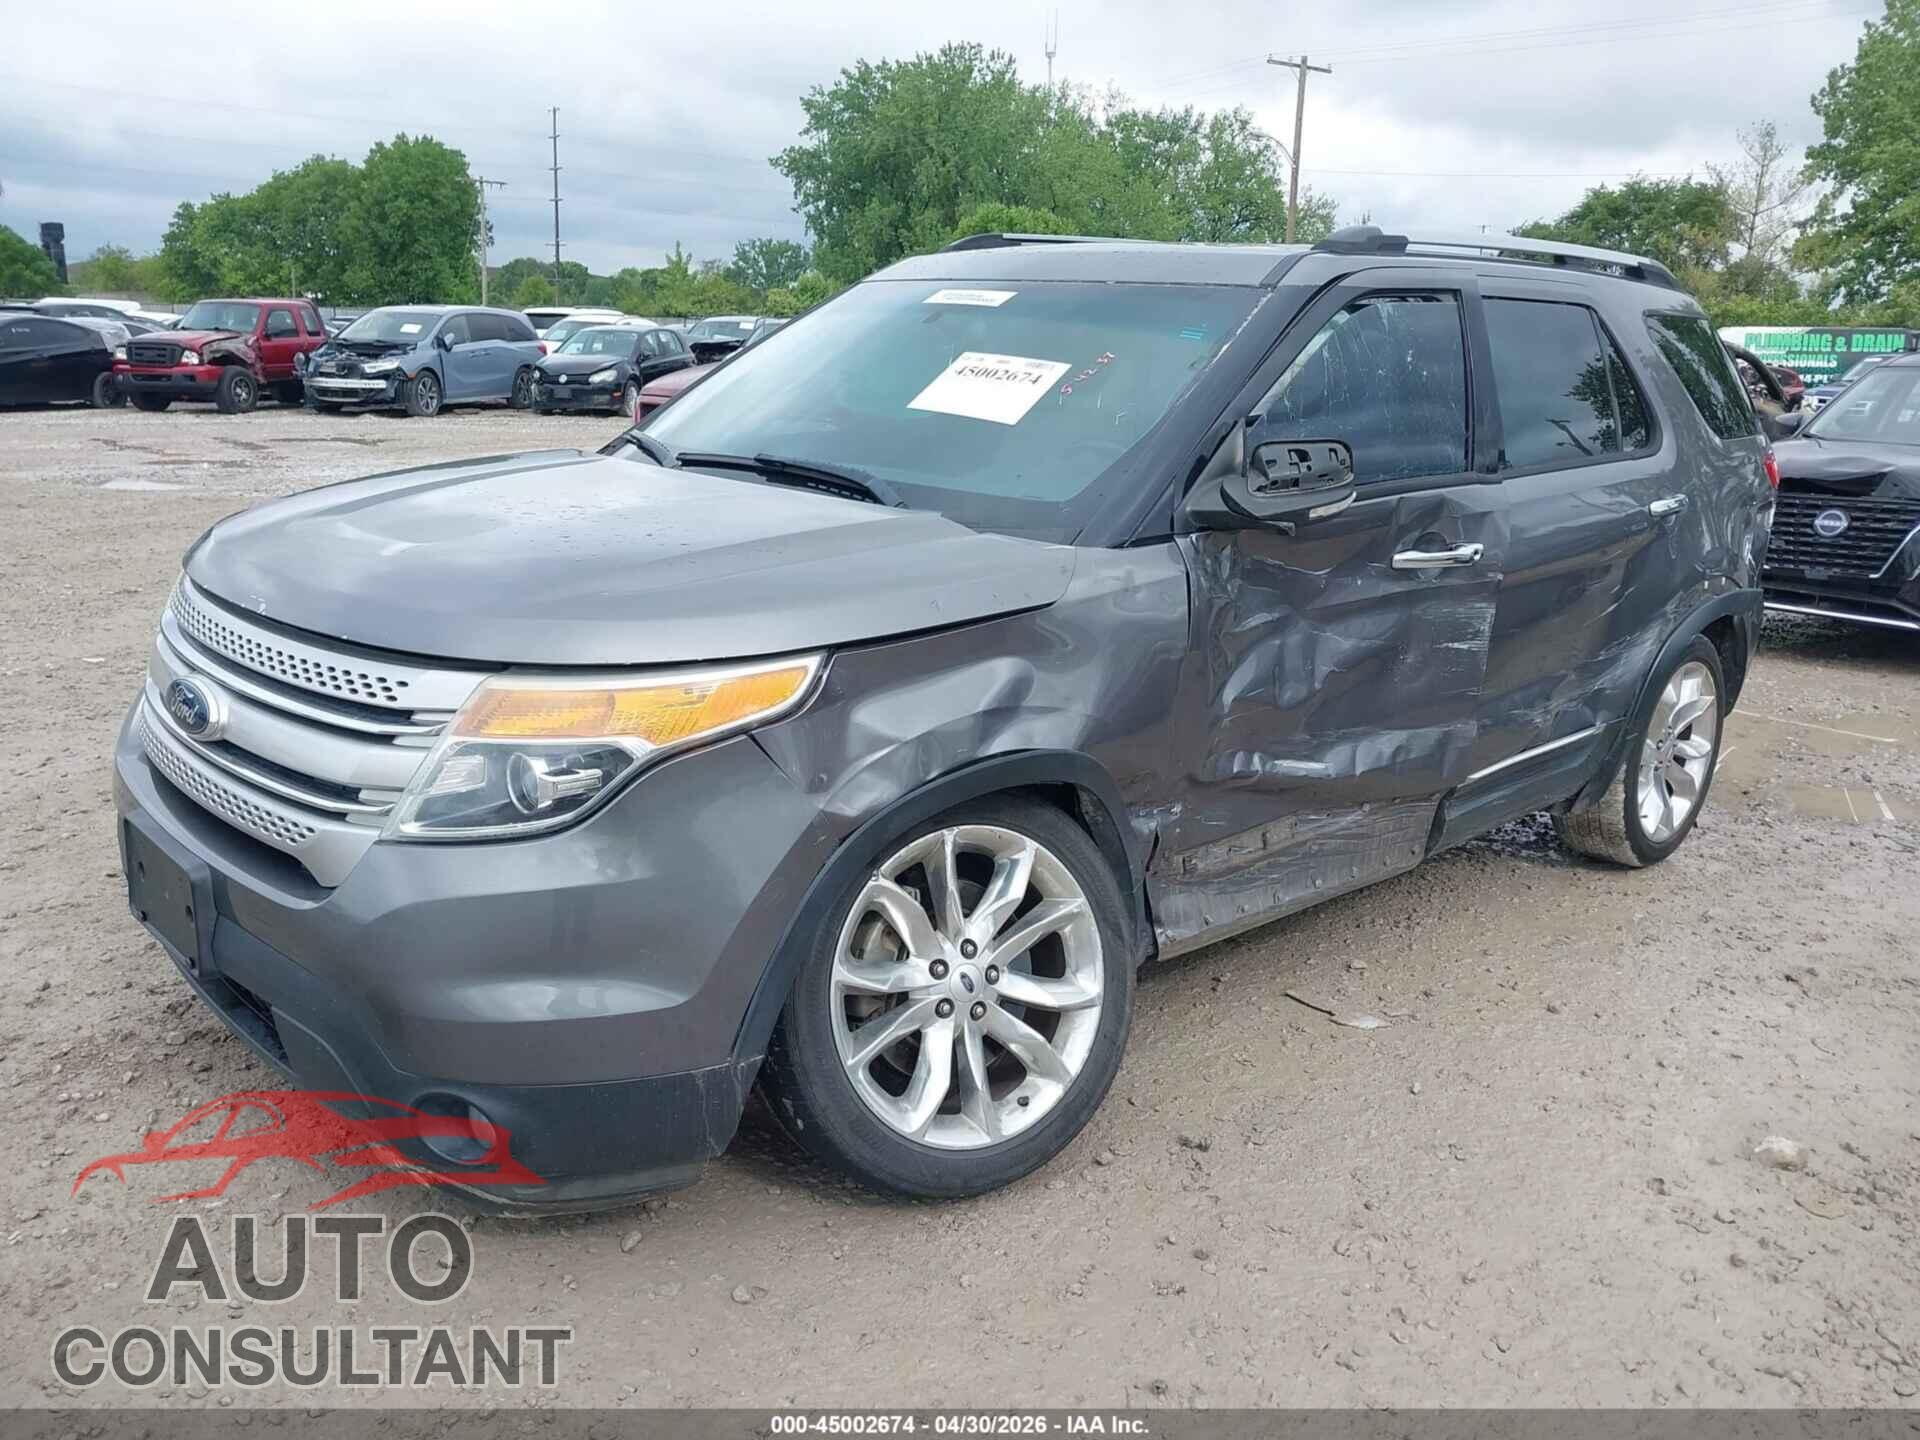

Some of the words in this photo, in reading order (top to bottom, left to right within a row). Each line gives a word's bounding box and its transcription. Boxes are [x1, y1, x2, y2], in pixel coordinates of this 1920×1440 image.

[1744, 332, 1832, 352] PLUMBING
[1834, 336, 1848, 352] &
[1851, 333, 1905, 352] DRAIN
[955, 366, 1044, 385] 45002674
[169, 686, 199, 726] Ford
